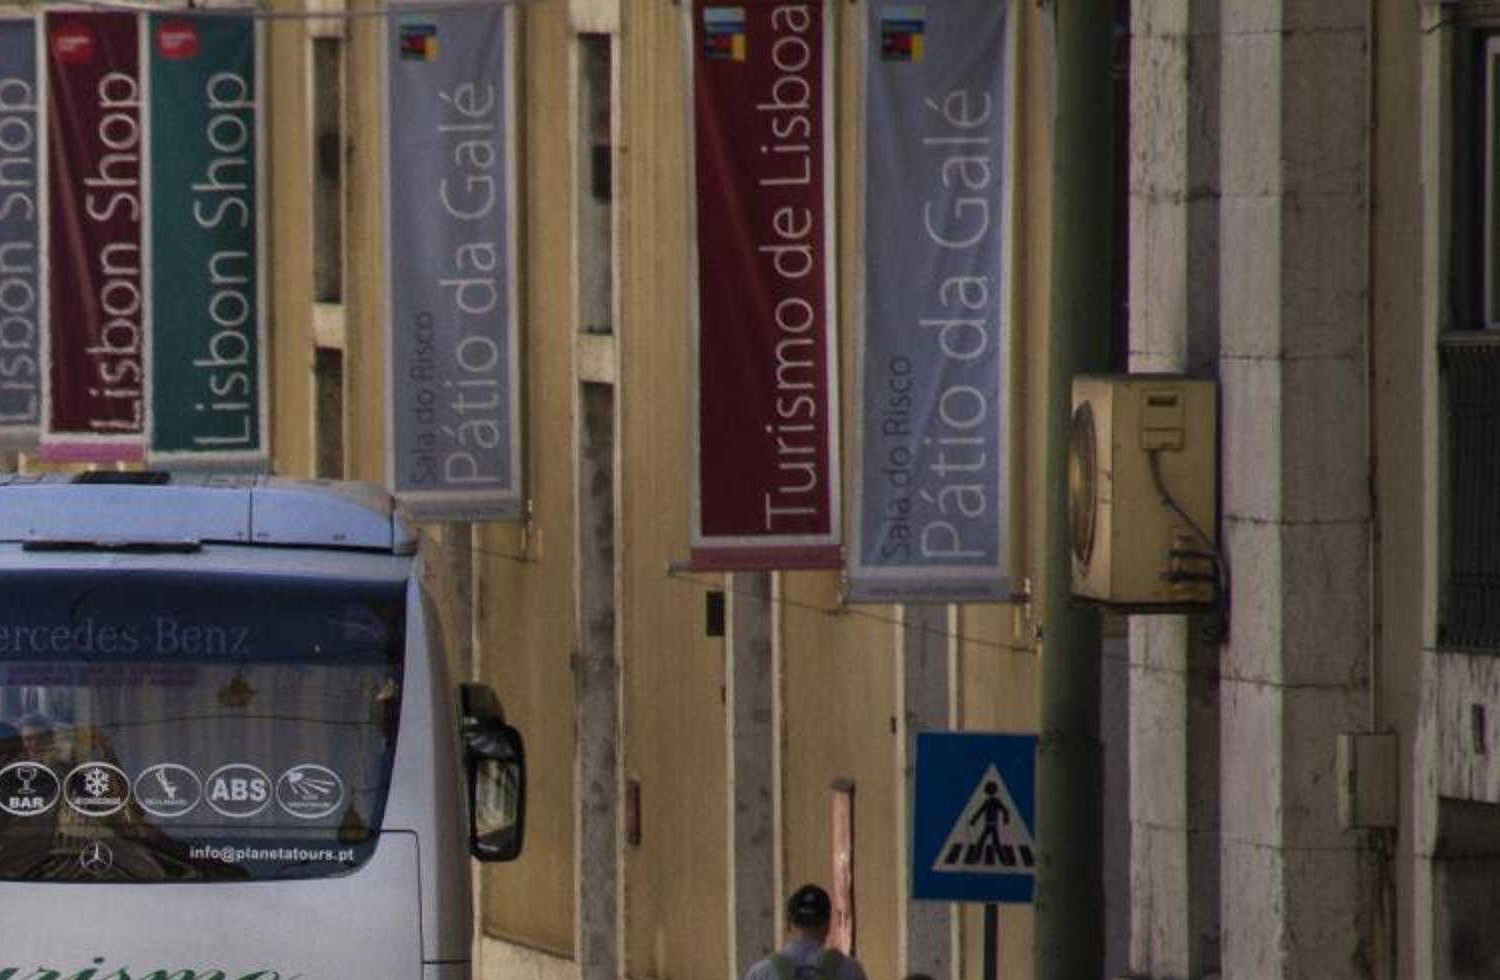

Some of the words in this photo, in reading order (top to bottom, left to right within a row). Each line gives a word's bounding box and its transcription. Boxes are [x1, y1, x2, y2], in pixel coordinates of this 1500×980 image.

[756, 5, 812, 187] Lisboa
[84, 72, 142, 222] Shop
[192, 71, 255, 228] Shop
[438, 83, 496, 220] Galé
[923, 86, 992, 249] Galé
[439, 243, 497, 315] da
[759, 205, 813, 278] de
[85, 243, 141, 431] Lisbon
[194, 251, 251, 447] Lisbon
[409, 310, 436, 381] Risco
[920, 275, 988, 361] da
[410, 388, 436, 425] do
[442, 334, 500, 485] Pátio
[765, 297, 817, 529] Turismo
[881, 354, 912, 437] Risco
[410, 432, 437, 486] Sala
[880, 445, 912, 488] do
[918, 384, 987, 558] Pátio
[880, 497, 912, 560] Sala
[9, 796, 45, 810] BAR
[211, 778, 268, 801] ABS
[189, 845, 354, 863] info@planetatours.pt
